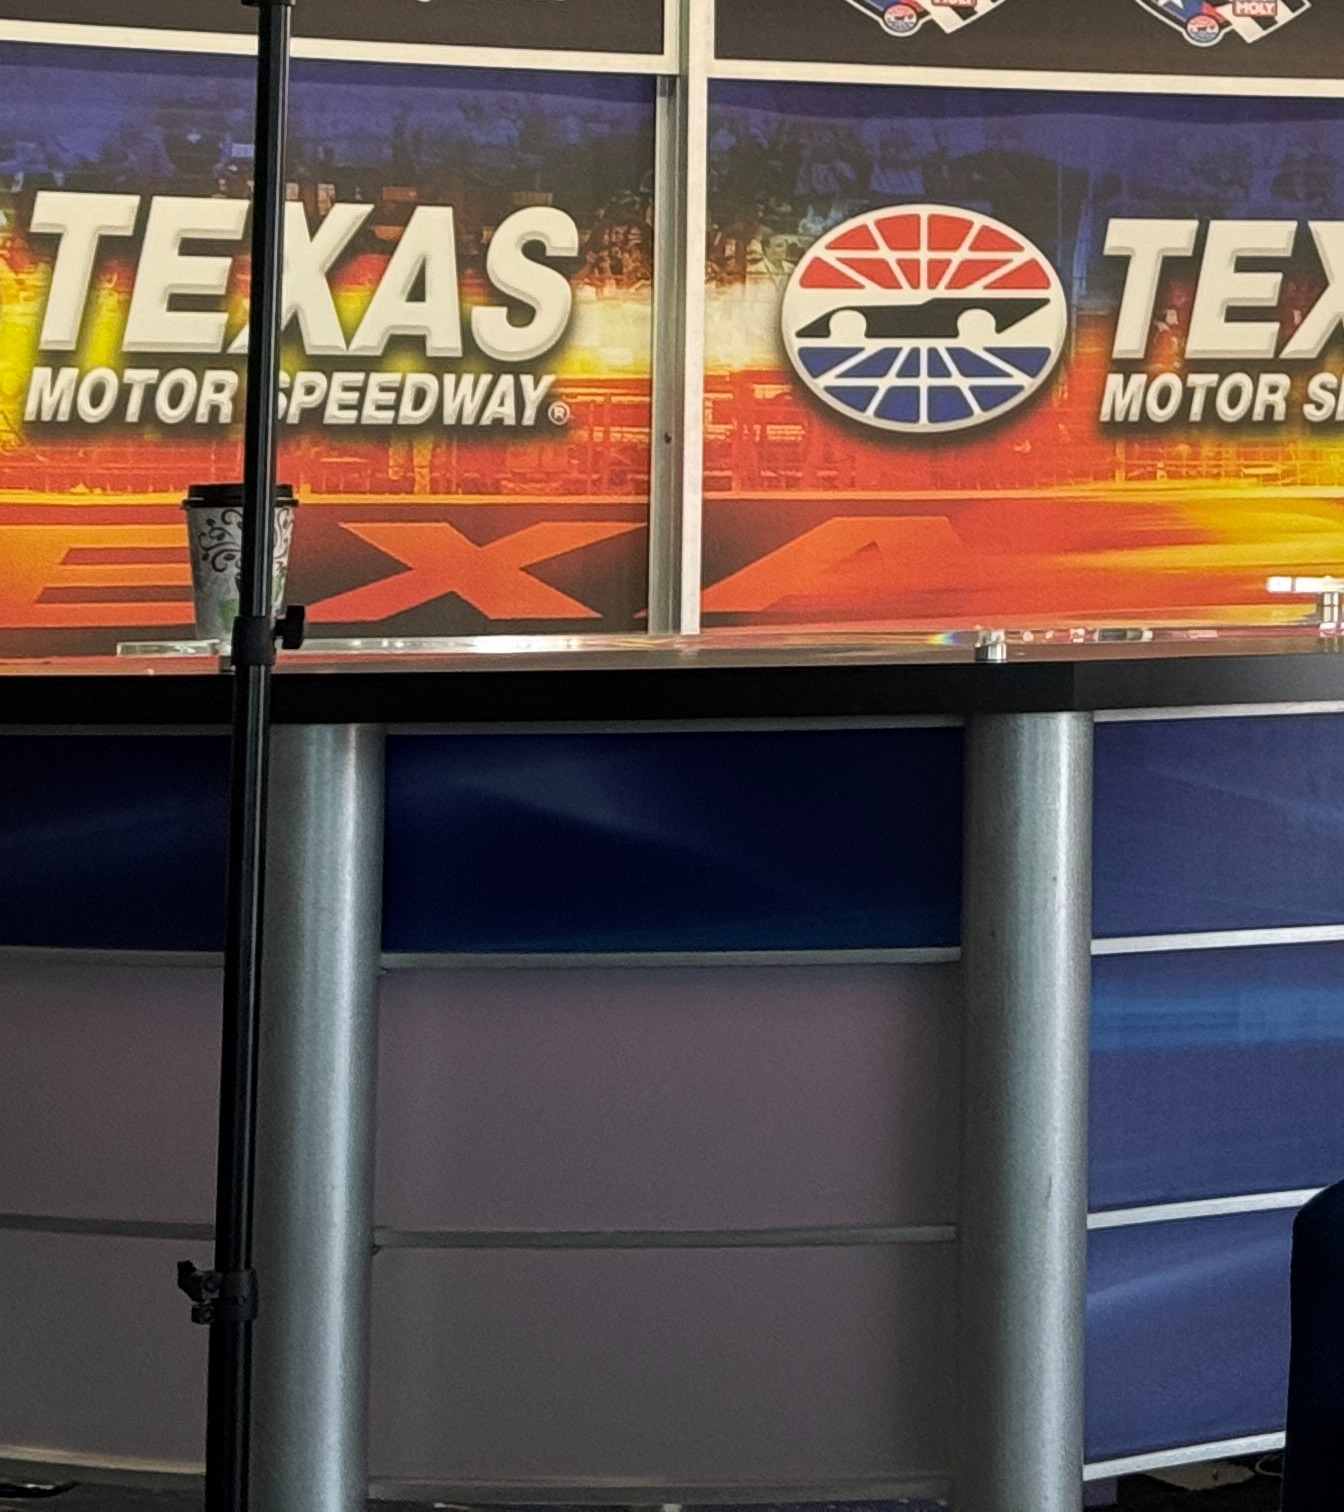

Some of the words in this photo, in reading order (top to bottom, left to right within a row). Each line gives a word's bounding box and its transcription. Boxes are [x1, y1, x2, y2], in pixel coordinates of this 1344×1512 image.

[1235, 1, 1275, 15] MOLY
[27, 189, 579, 361] TEXAS
[23, 366, 239, 424] MOTOR
[1099, 372, 1292, 422] MOTOR
